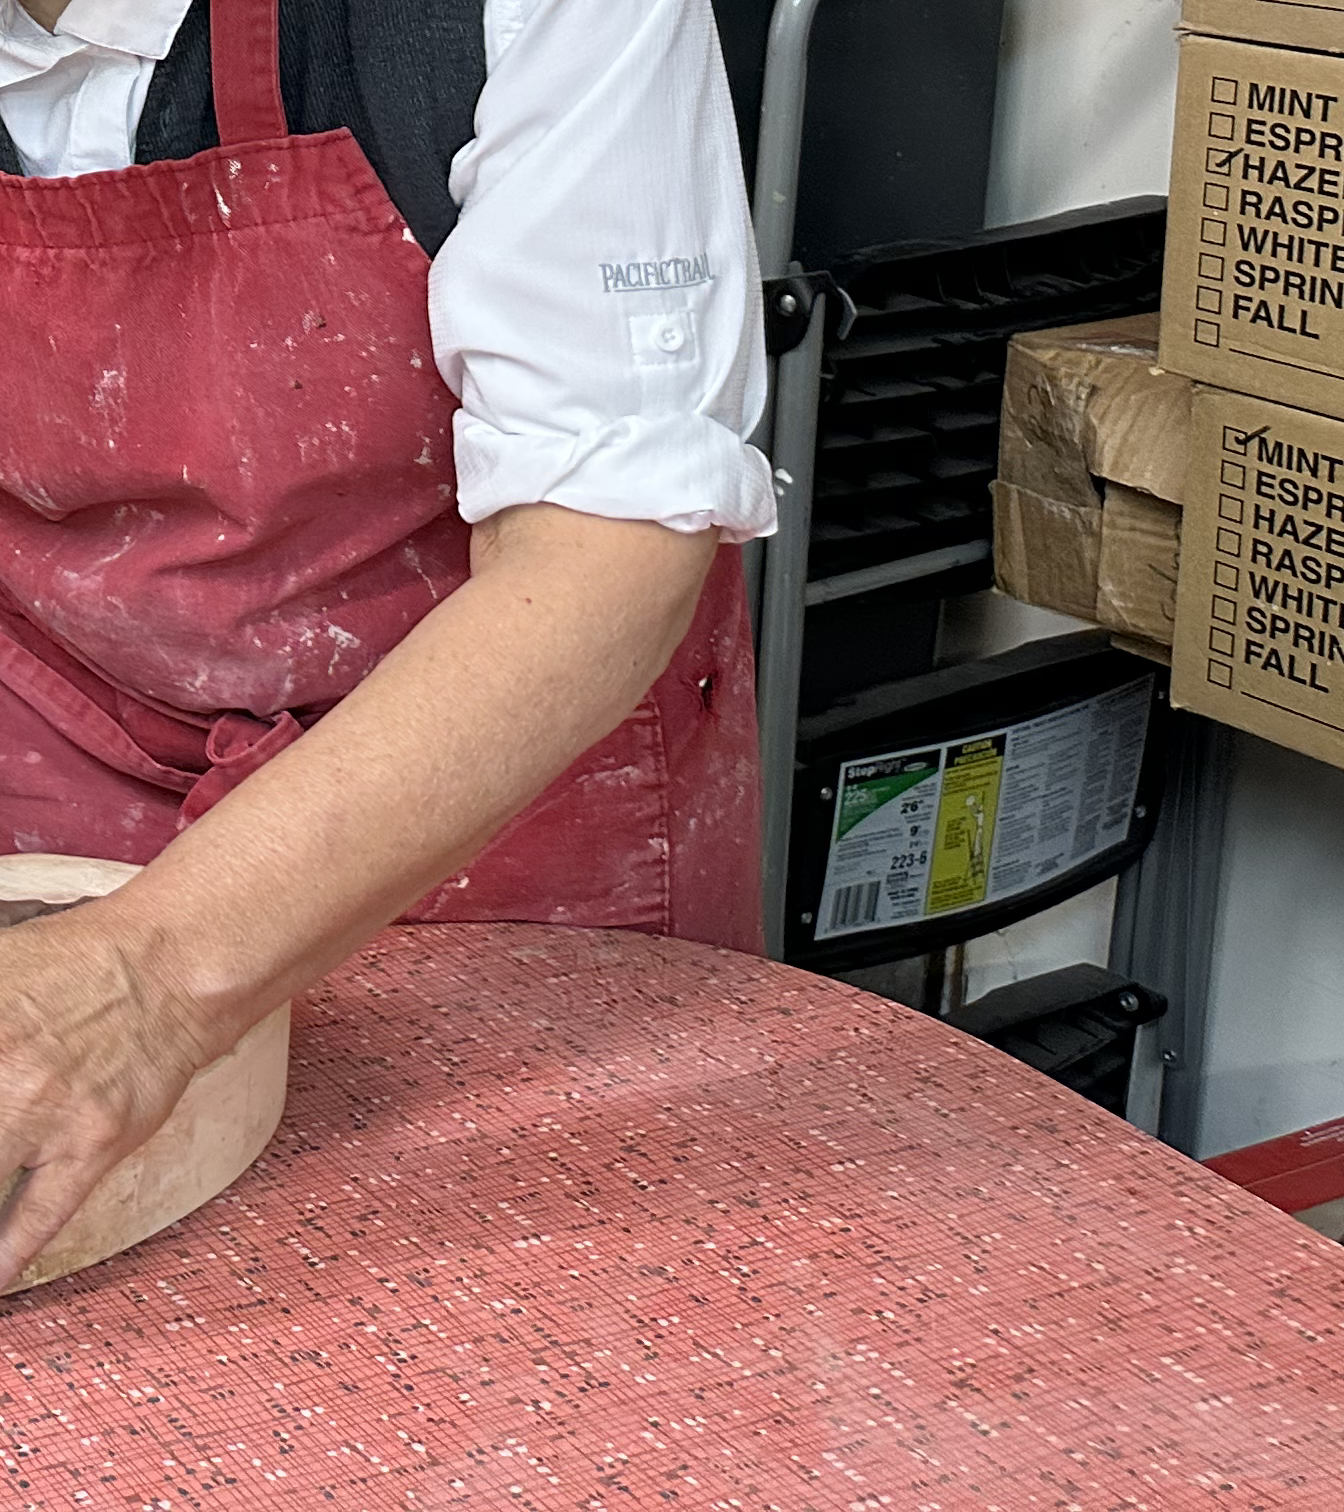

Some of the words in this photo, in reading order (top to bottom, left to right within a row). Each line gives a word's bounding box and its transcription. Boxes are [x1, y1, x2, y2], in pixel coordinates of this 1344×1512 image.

[1247, 82, 1338, 122] MINT
[1242, 153, 1344, 199] HAZE
[1240, 188, 1344, 236] RASP
[1233, 259, 1344, 309] SPRIN
[1232, 293, 1320, 340] FALL
[1257, 434, 1344, 483] MINT
[1248, 570, 1344, 630] WHIT
[1244, 638, 1330, 693] FALL
[890, 850, 927, 870] 223-6
